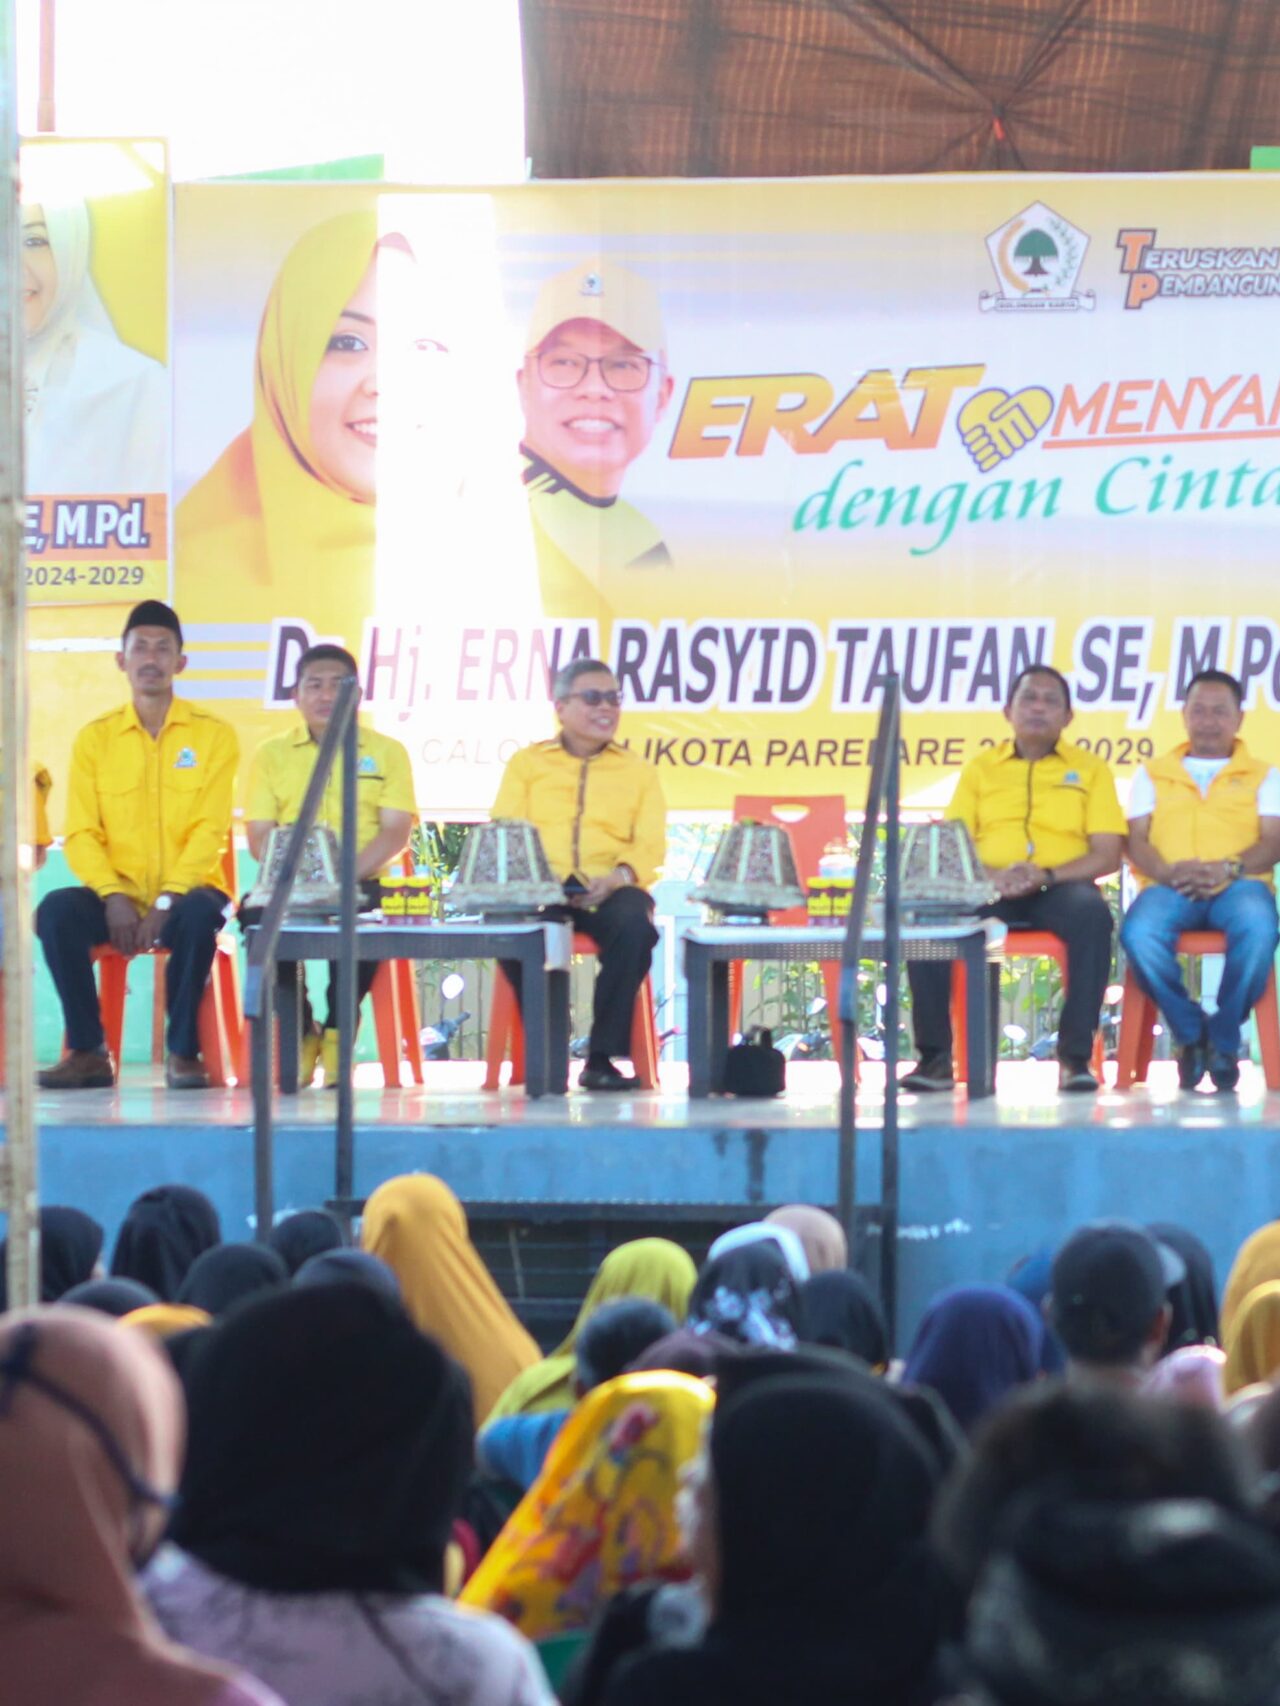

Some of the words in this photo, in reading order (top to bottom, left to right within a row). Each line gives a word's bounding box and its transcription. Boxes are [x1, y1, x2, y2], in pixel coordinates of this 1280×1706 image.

[1117, 229, 1280, 273] TERUSKAN
[668, 363, 986, 459] ERAT
[55, 501, 149, 546] M.Pd.
[792, 459, 1063, 556] dengan
[615, 626, 817, 703] RASYID
[1076, 625, 1154, 720] SE,
[421, 738, 536, 764] CALO
[765, 738, 965, 766] PAREARE
